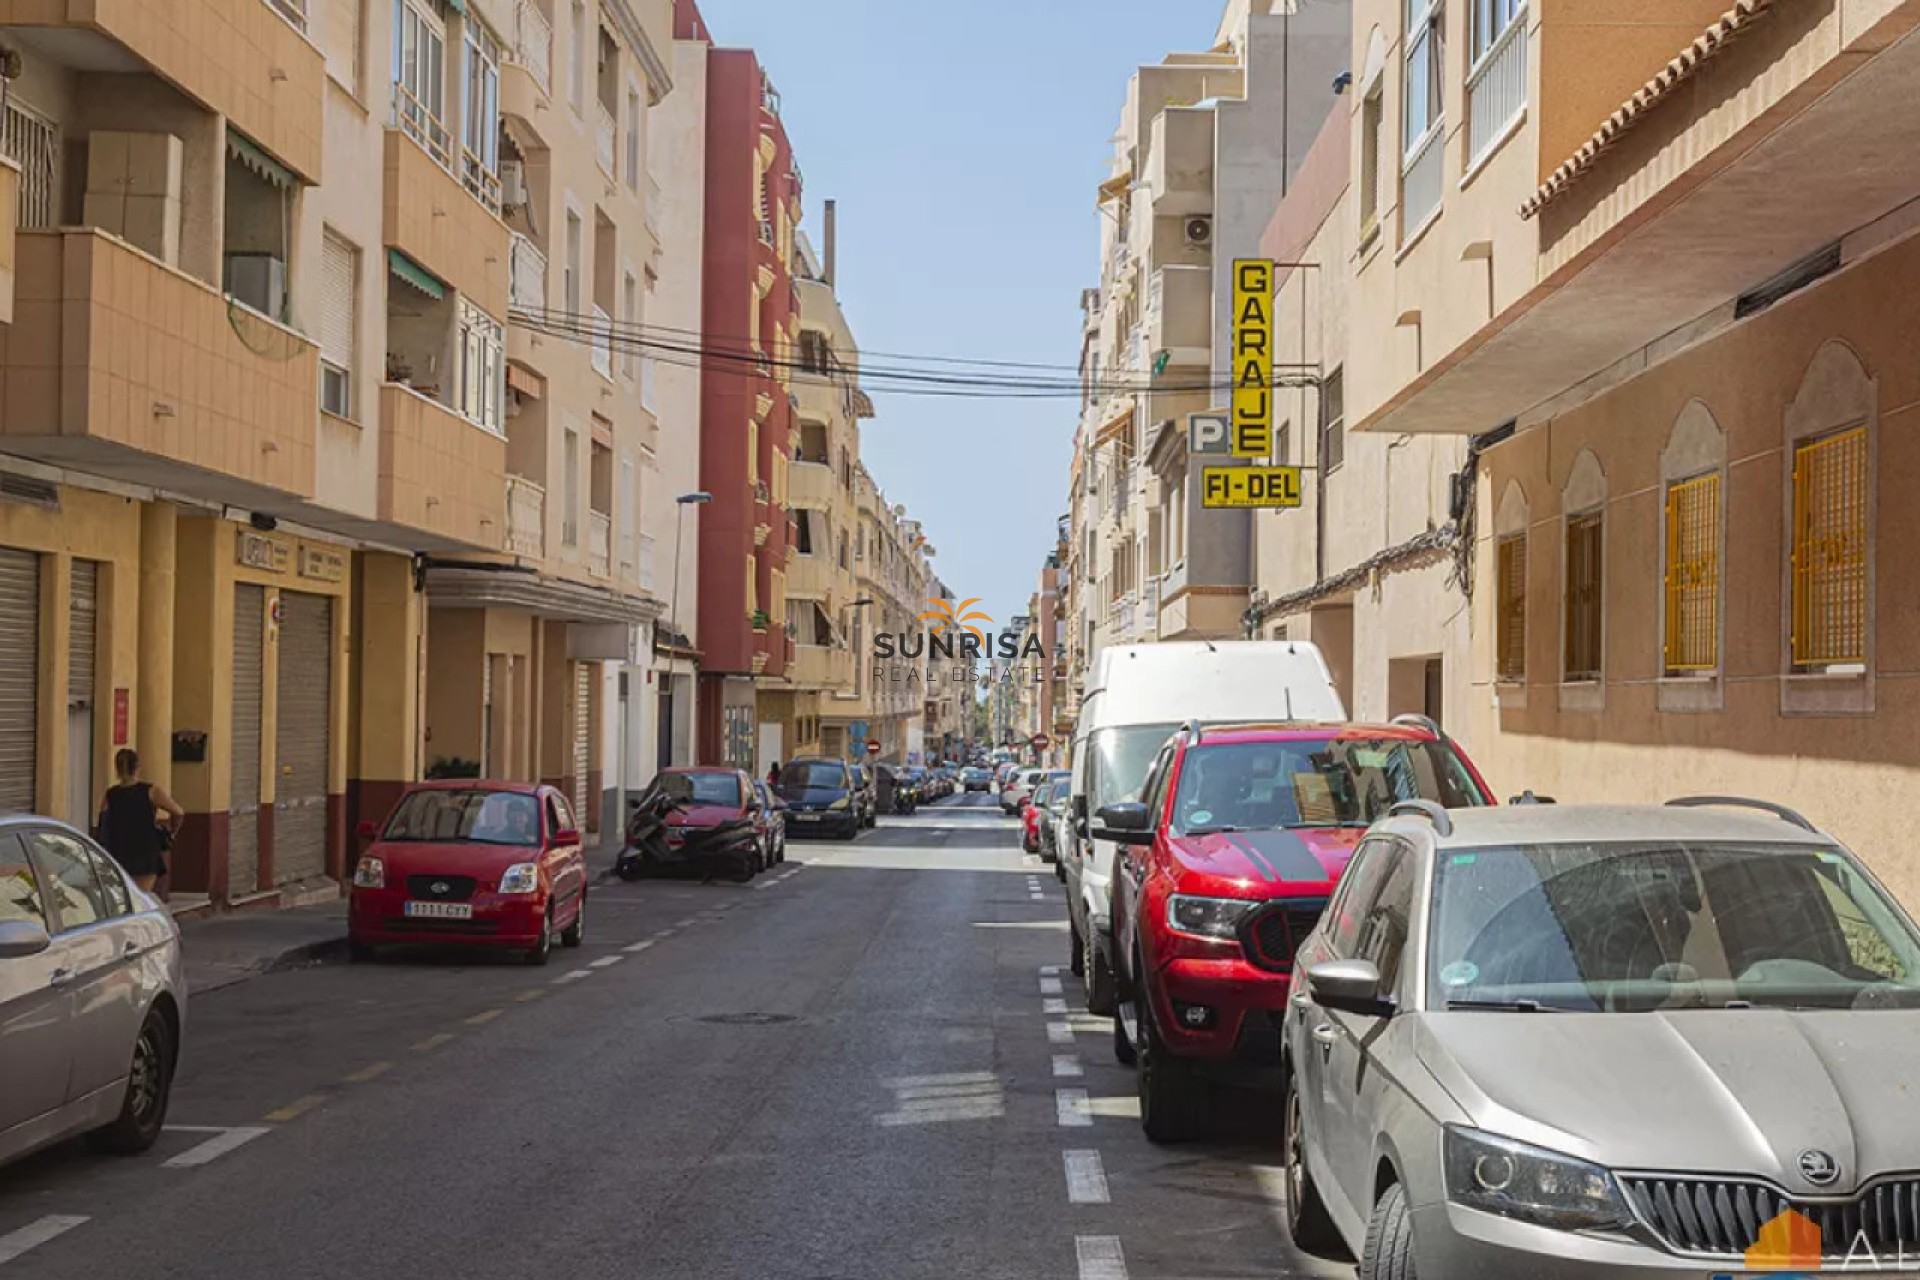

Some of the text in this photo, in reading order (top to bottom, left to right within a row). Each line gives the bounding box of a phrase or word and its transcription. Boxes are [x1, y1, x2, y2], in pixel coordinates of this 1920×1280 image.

[1239, 265, 1267, 451] GARAJE
[1194, 419, 1224, 450] P
[1207, 473, 1297, 499] FI-DEL
